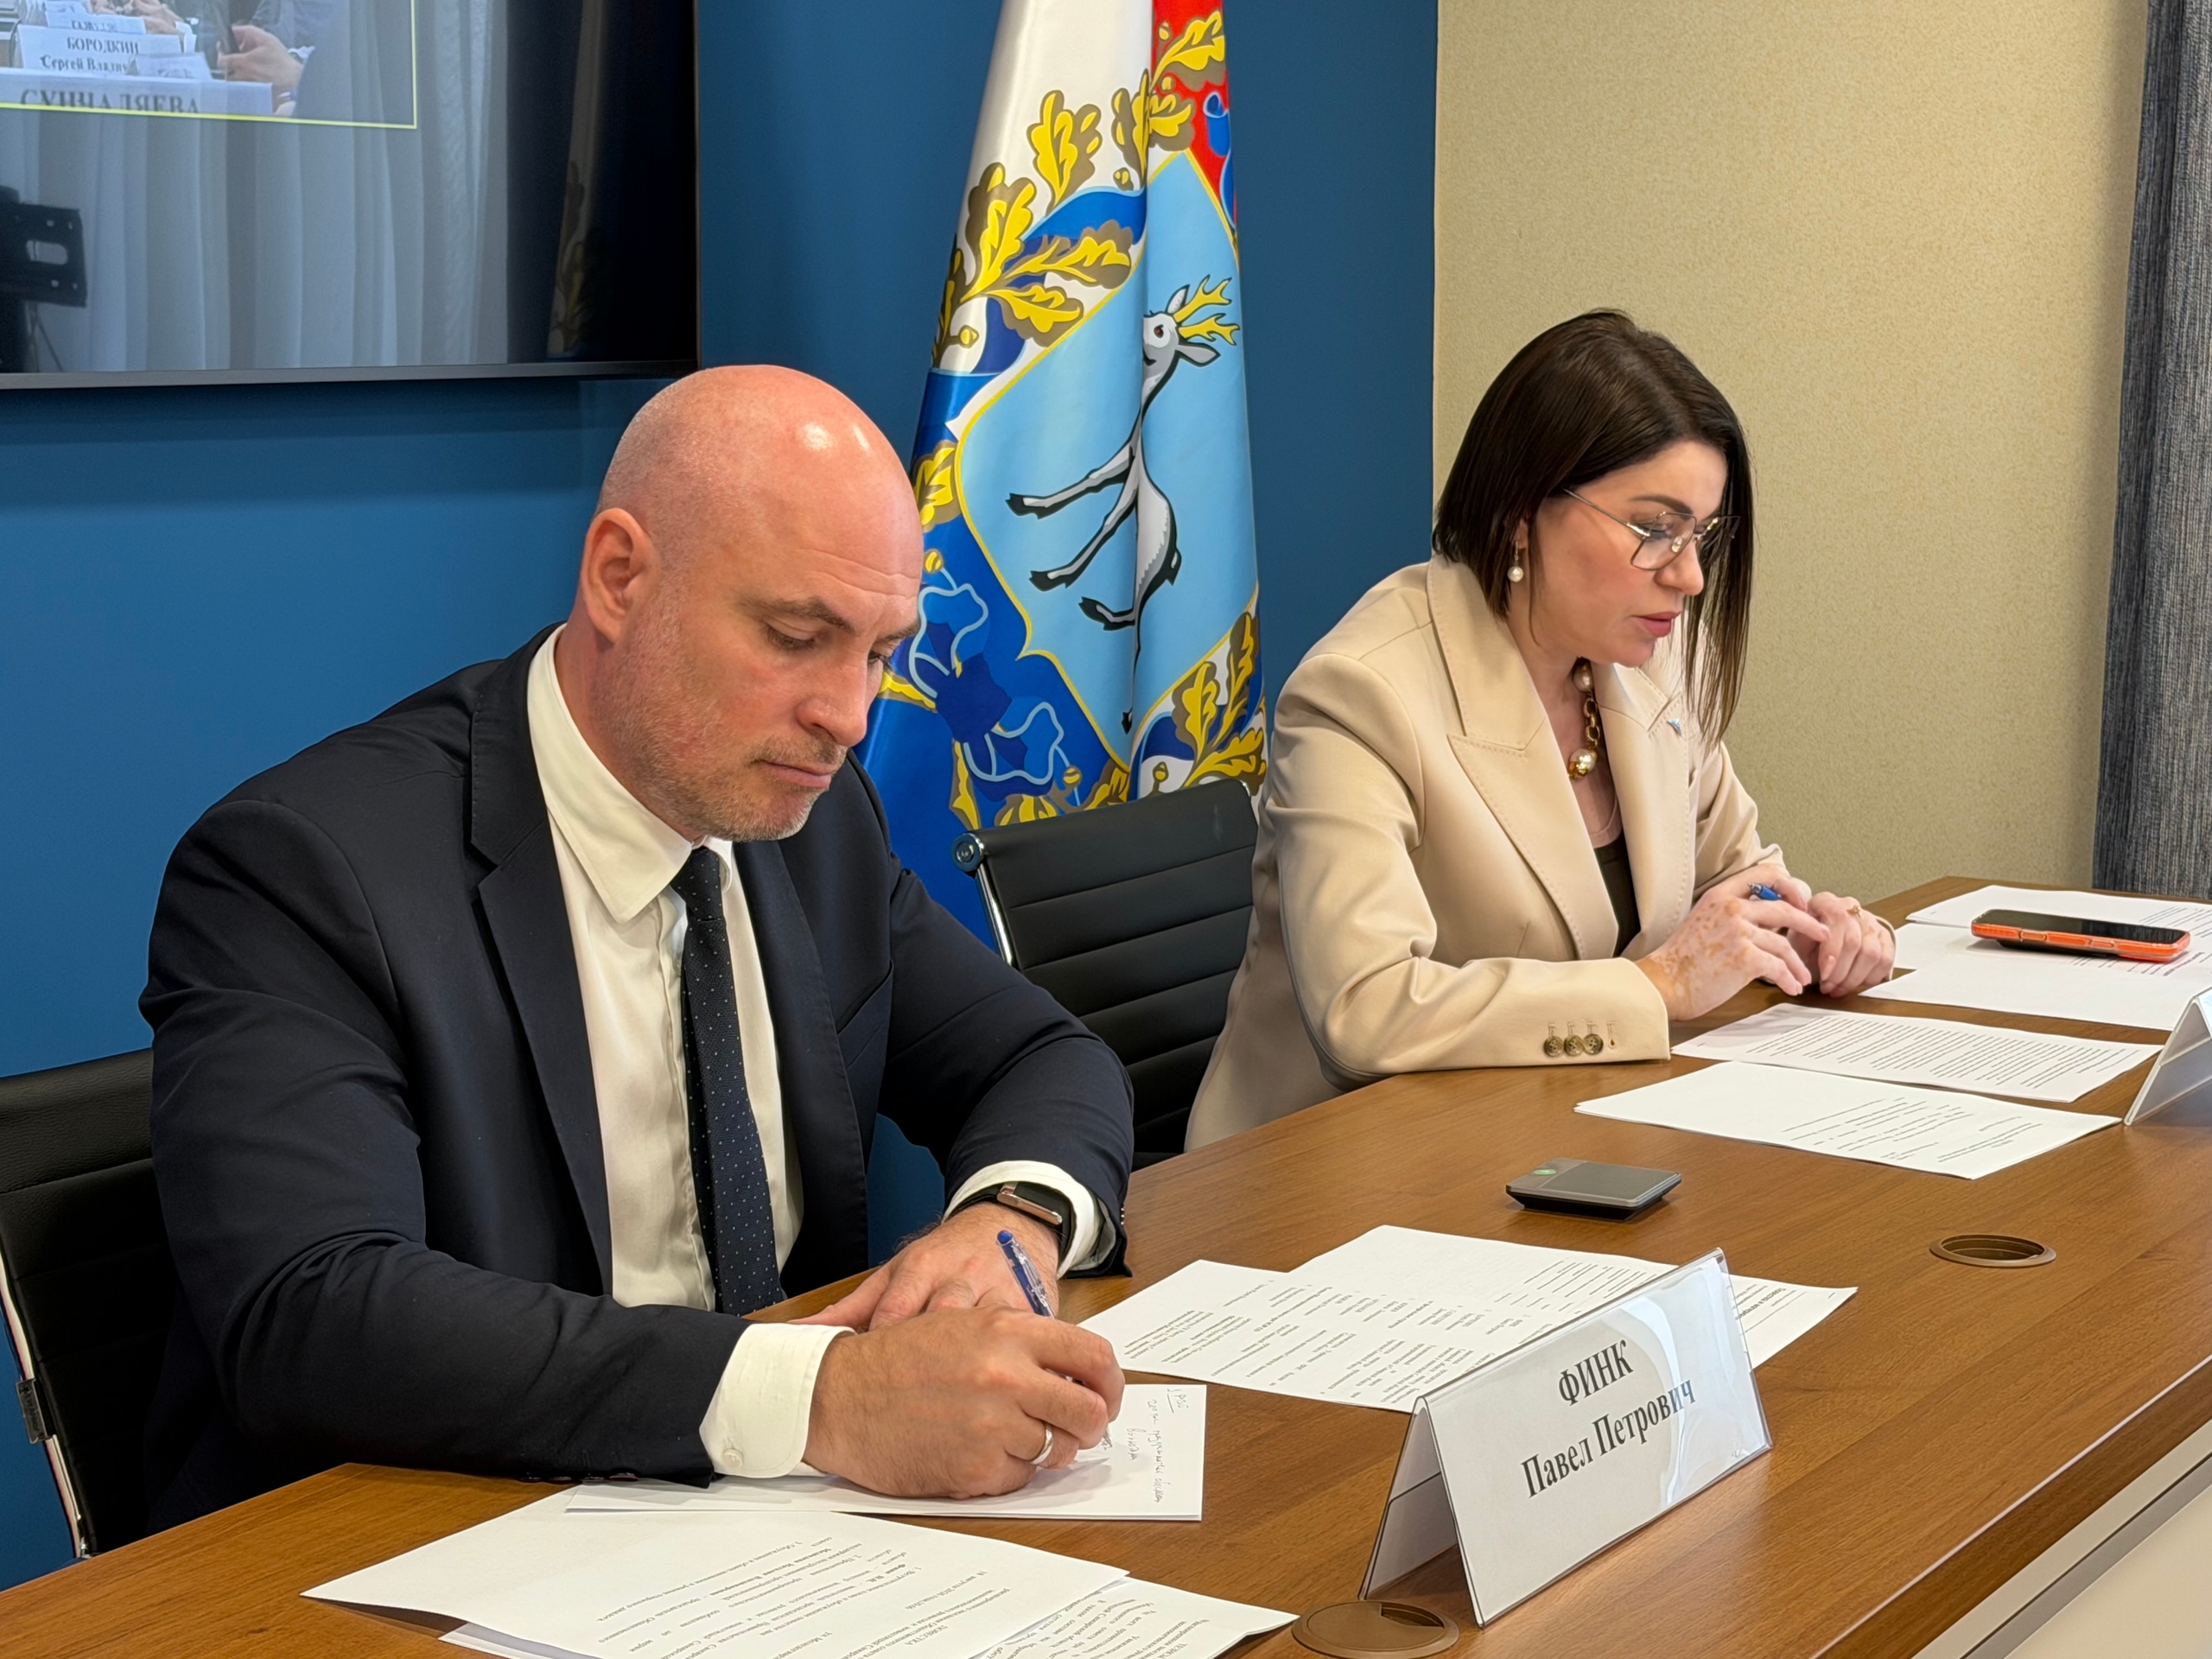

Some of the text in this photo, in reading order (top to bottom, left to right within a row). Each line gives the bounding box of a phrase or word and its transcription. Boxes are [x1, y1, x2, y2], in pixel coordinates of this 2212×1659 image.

[1558, 1338, 1634, 1407] ФИНК
[1520, 1379, 1696, 1499] Павел Петрович
